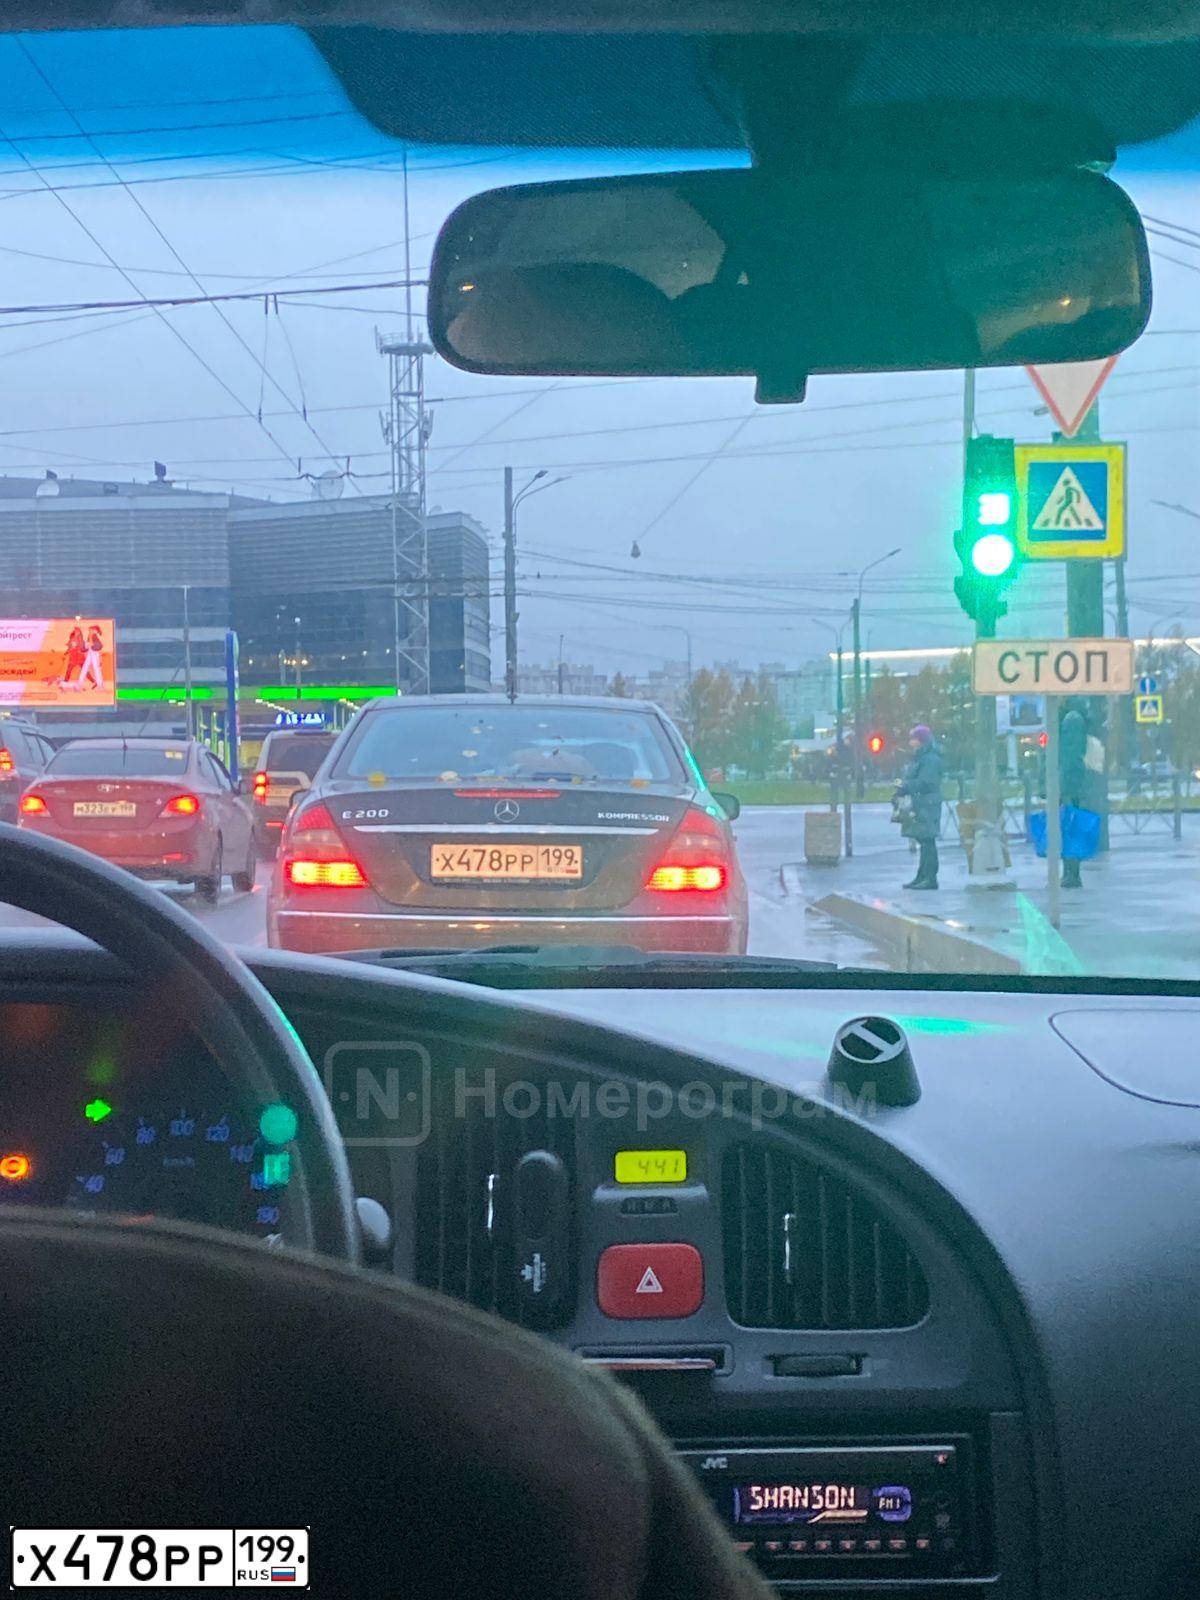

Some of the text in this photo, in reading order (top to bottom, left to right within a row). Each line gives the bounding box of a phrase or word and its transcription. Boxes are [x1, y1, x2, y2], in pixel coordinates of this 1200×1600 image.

[997, 650, 1109, 684] СТОП
[342, 808, 389, 819] E 200
[597, 811, 670, 822] KOMPRESSOR
[541, 848, 575, 866] 199
[700, 1456, 729, 1470] JVC
[749, 1485, 855, 1511] SHANSON
